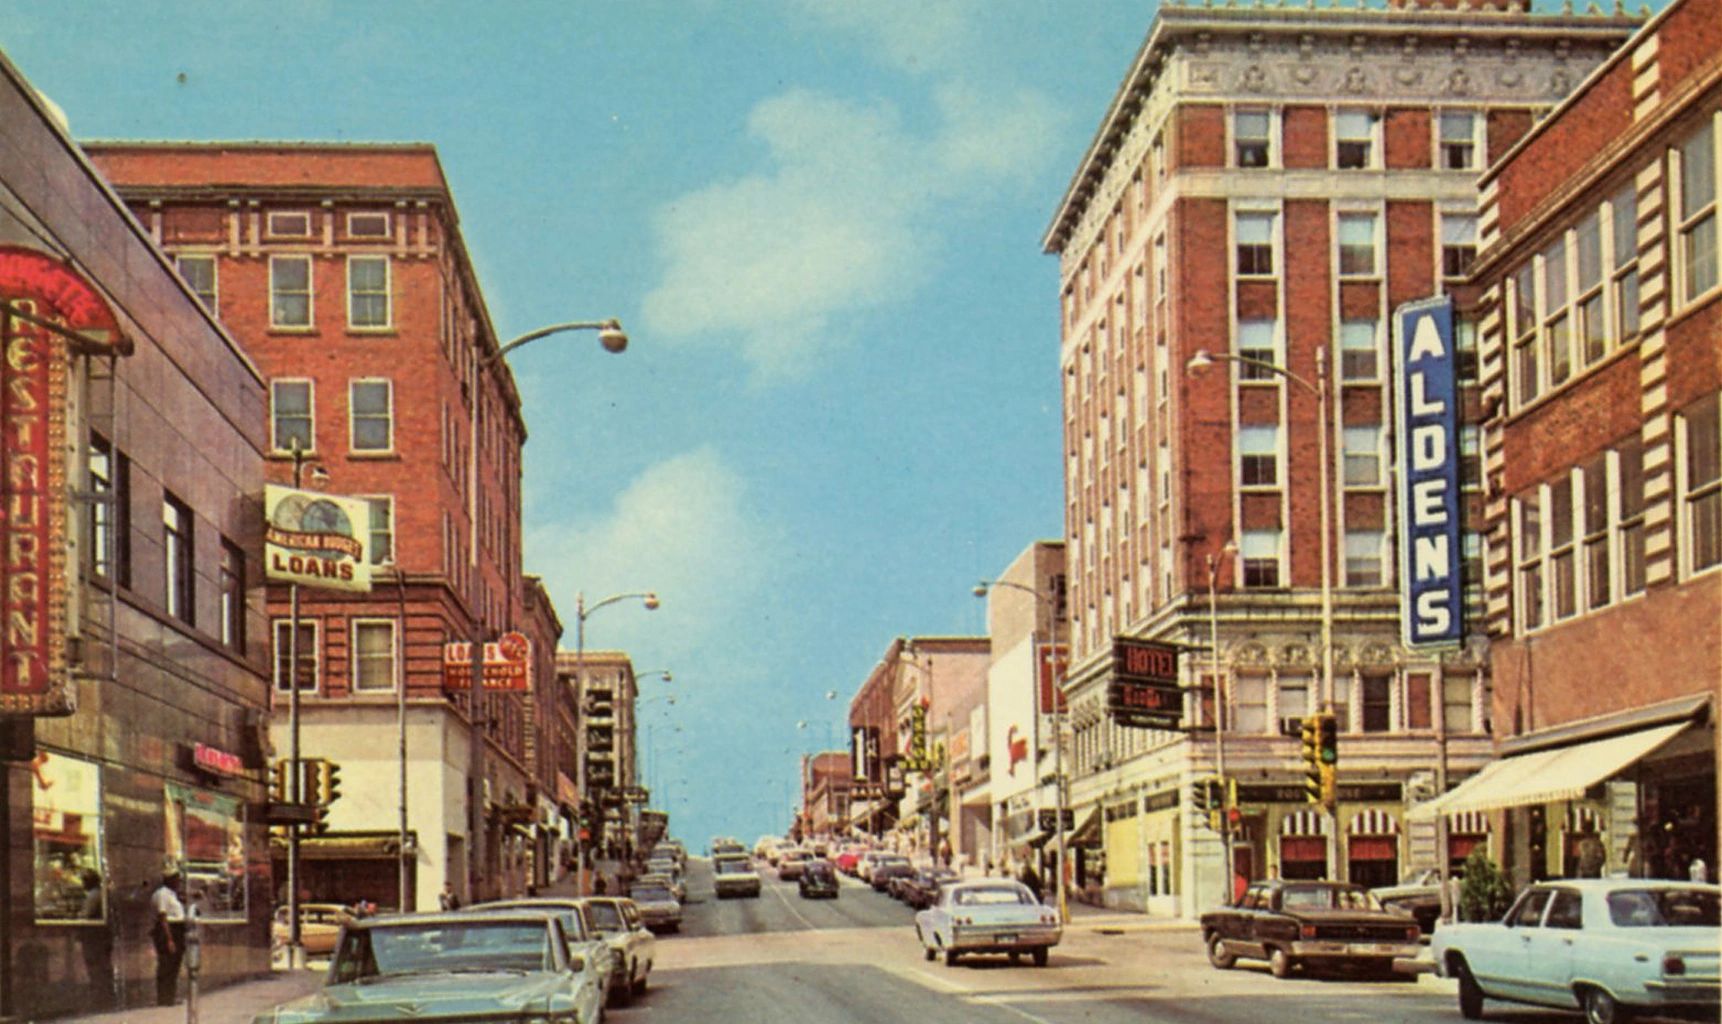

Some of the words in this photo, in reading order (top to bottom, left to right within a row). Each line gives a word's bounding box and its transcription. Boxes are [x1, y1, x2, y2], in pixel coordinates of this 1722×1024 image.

[1409, 314, 1450, 636] ALDENS
[7, 298, 41, 687] RESTAURANT
[272, 552, 354, 581] LOANS
[447, 643, 496, 662] LOS
[1126, 647, 1174, 677] HOTEL
[459, 678, 512, 688] FIANCE
